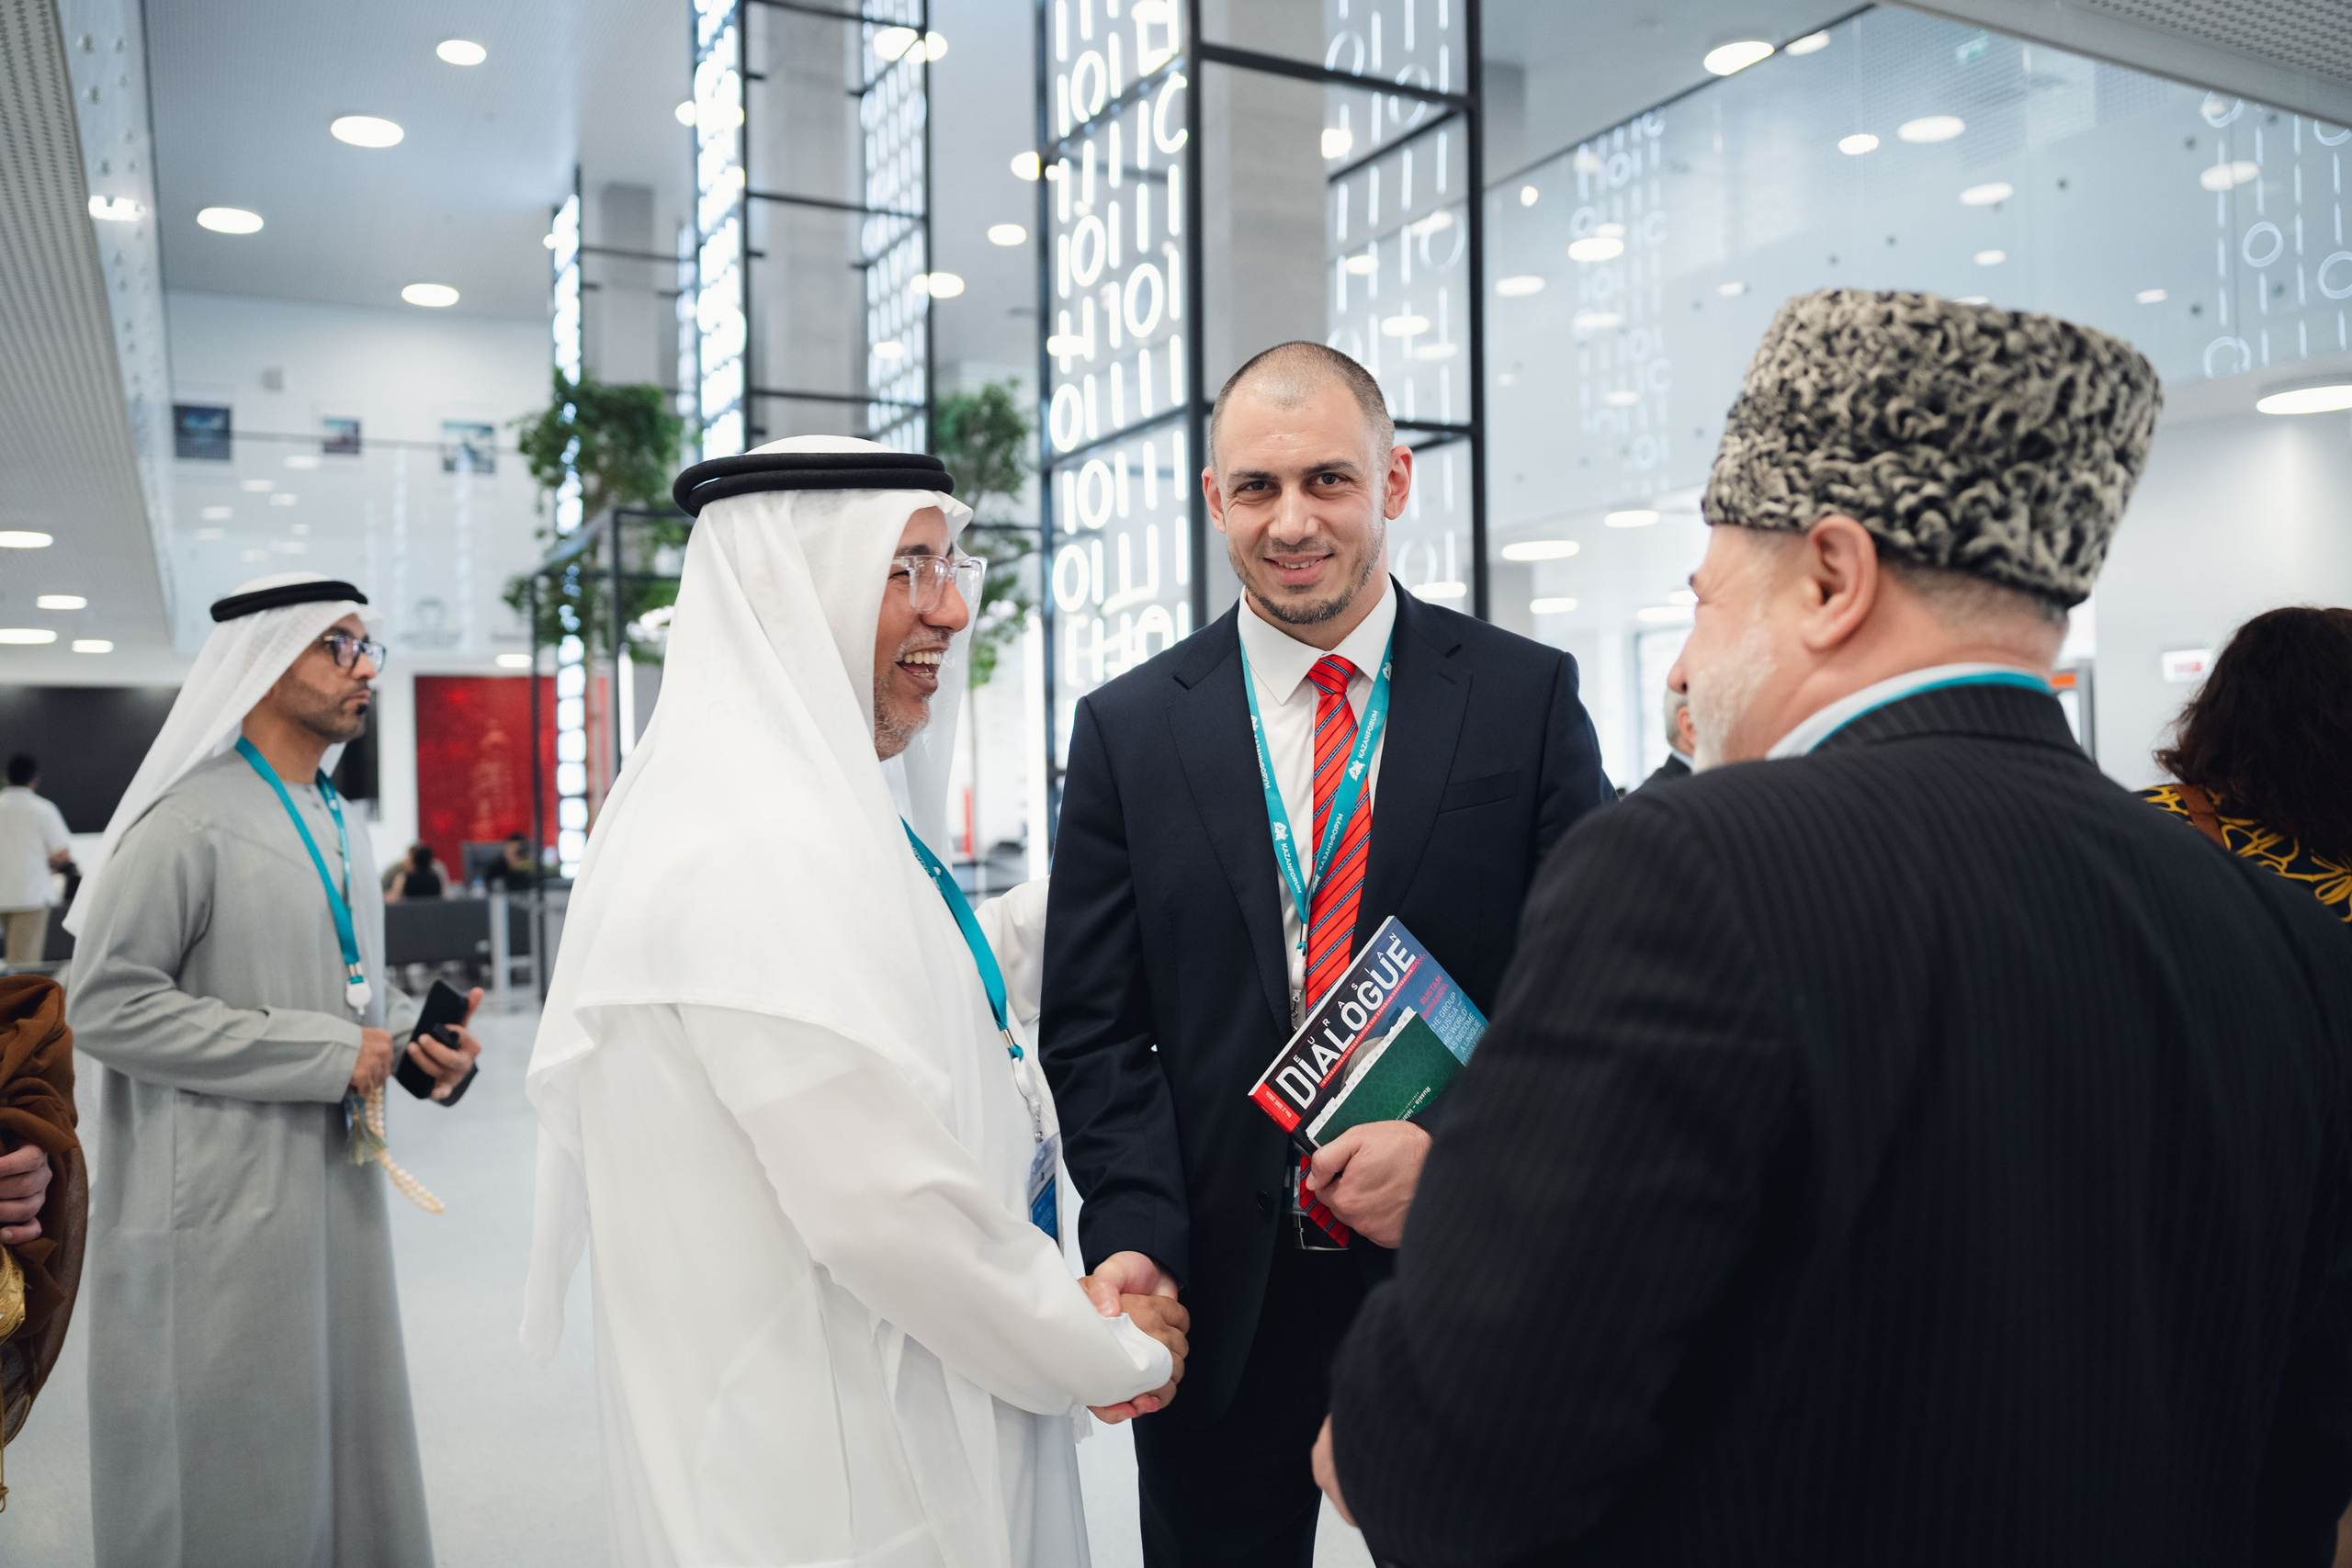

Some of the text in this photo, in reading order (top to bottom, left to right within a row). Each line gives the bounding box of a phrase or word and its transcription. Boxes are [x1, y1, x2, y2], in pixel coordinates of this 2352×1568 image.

[1357, 710, 1378, 759] KAZANFORUM
[1318, 813, 1344, 871] КАЗАНЬФОРУМ
[1281, 843, 1302, 894] KAZANFORUM
[1293, 932, 1397, 1063] EURASIAN
[1419, 975, 1442, 1006] RUSTAM
[1439, 991, 1456, 1018] GROUP
[1275, 938, 1416, 1110] DIALOGUE
[1455, 1012, 1476, 1043] BECOME
[1460, 1020, 1481, 1054] A UNIQUE
[1415, 1086, 1431, 1104] Russia
